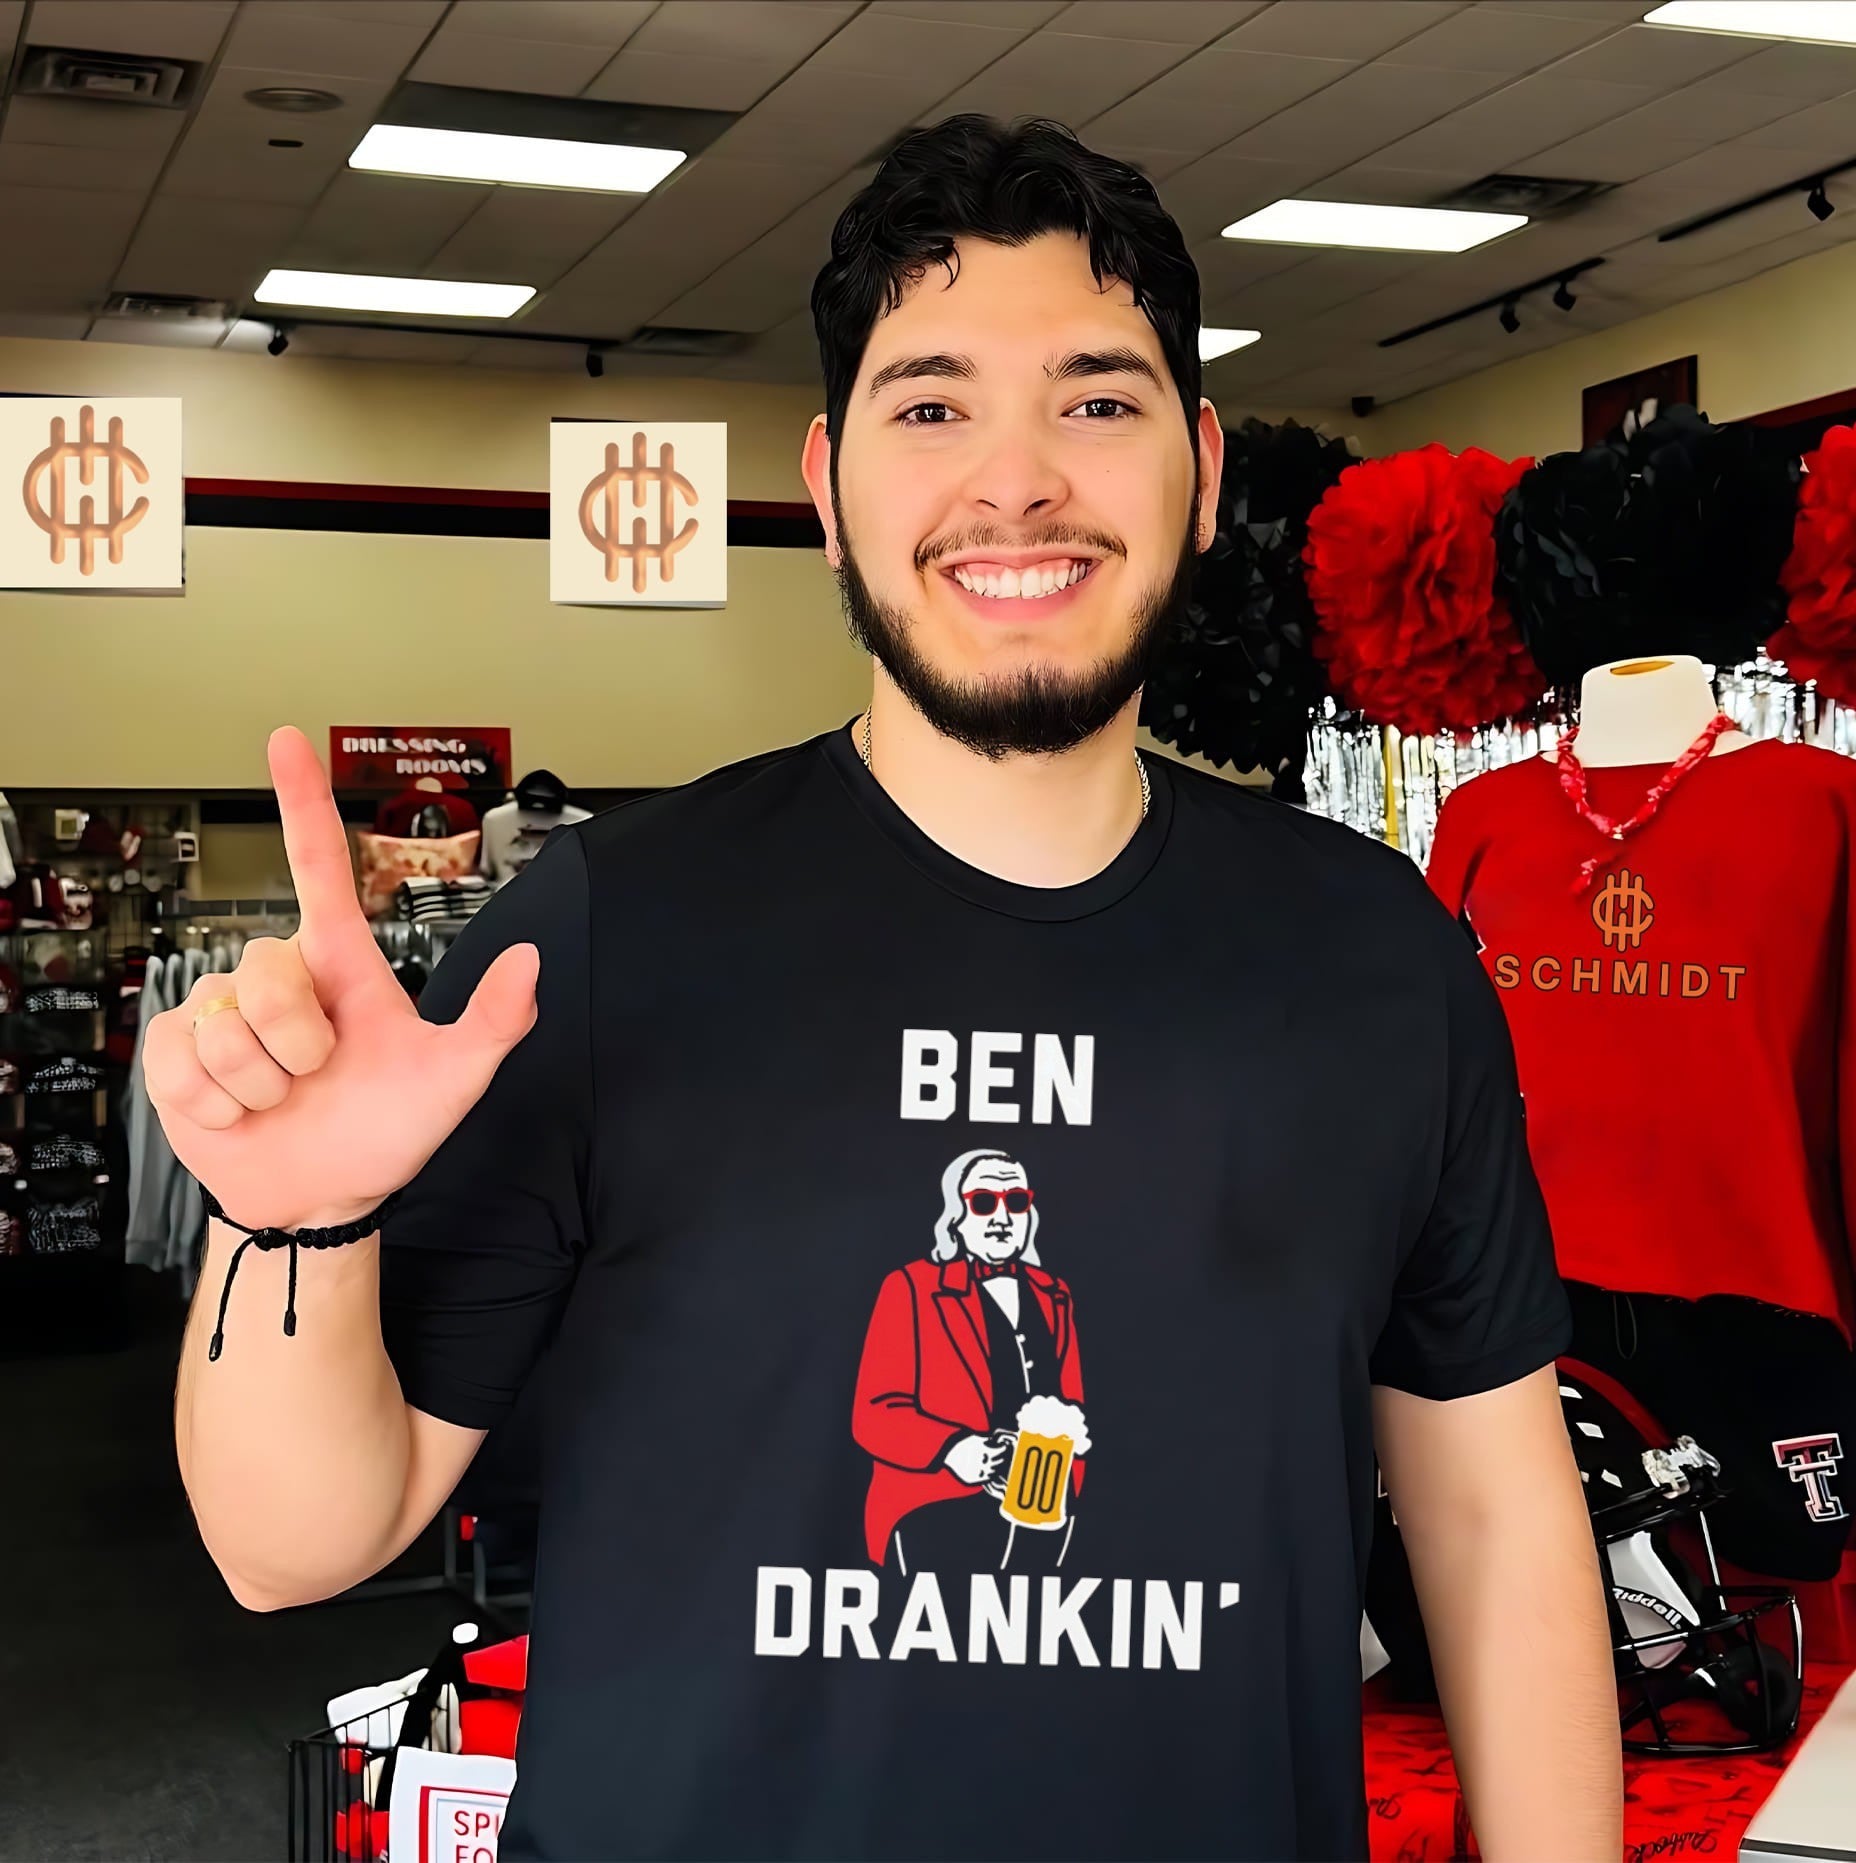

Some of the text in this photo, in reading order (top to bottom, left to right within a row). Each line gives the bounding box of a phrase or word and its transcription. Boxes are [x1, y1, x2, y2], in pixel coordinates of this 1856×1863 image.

[396, 758, 487, 775] ROOMS
[1494, 954, 1746, 1000] SCHMIDT
[900, 1029, 1095, 1126] BEN
[754, 1566, 1240, 1671] DRANKIN'
